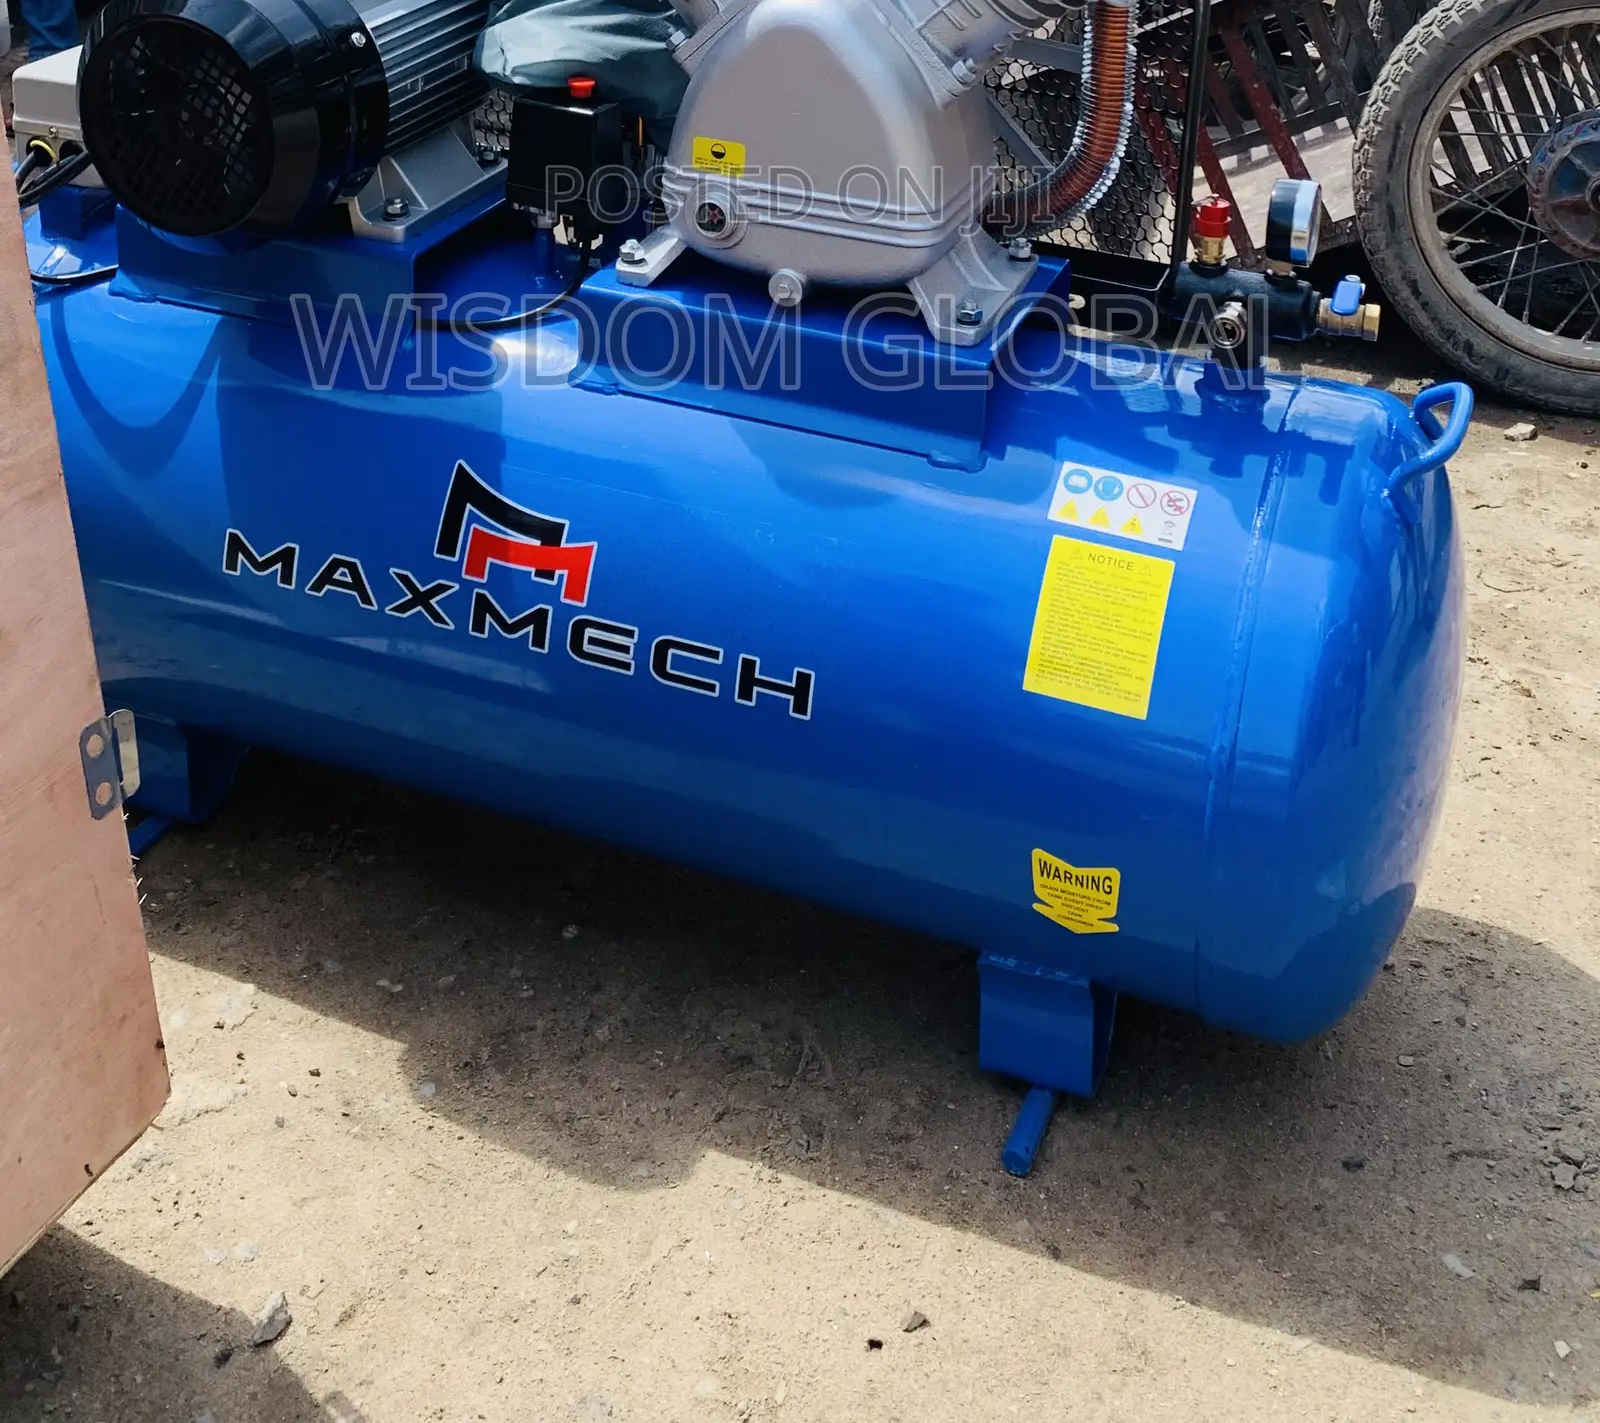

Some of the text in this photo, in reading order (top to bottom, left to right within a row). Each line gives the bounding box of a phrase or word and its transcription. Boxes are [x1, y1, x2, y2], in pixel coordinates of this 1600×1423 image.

[1088, 551, 1135, 571] NOTICE
[222, 528, 816, 721] MAXMECH
[1038, 857, 1113, 896] WARNING
